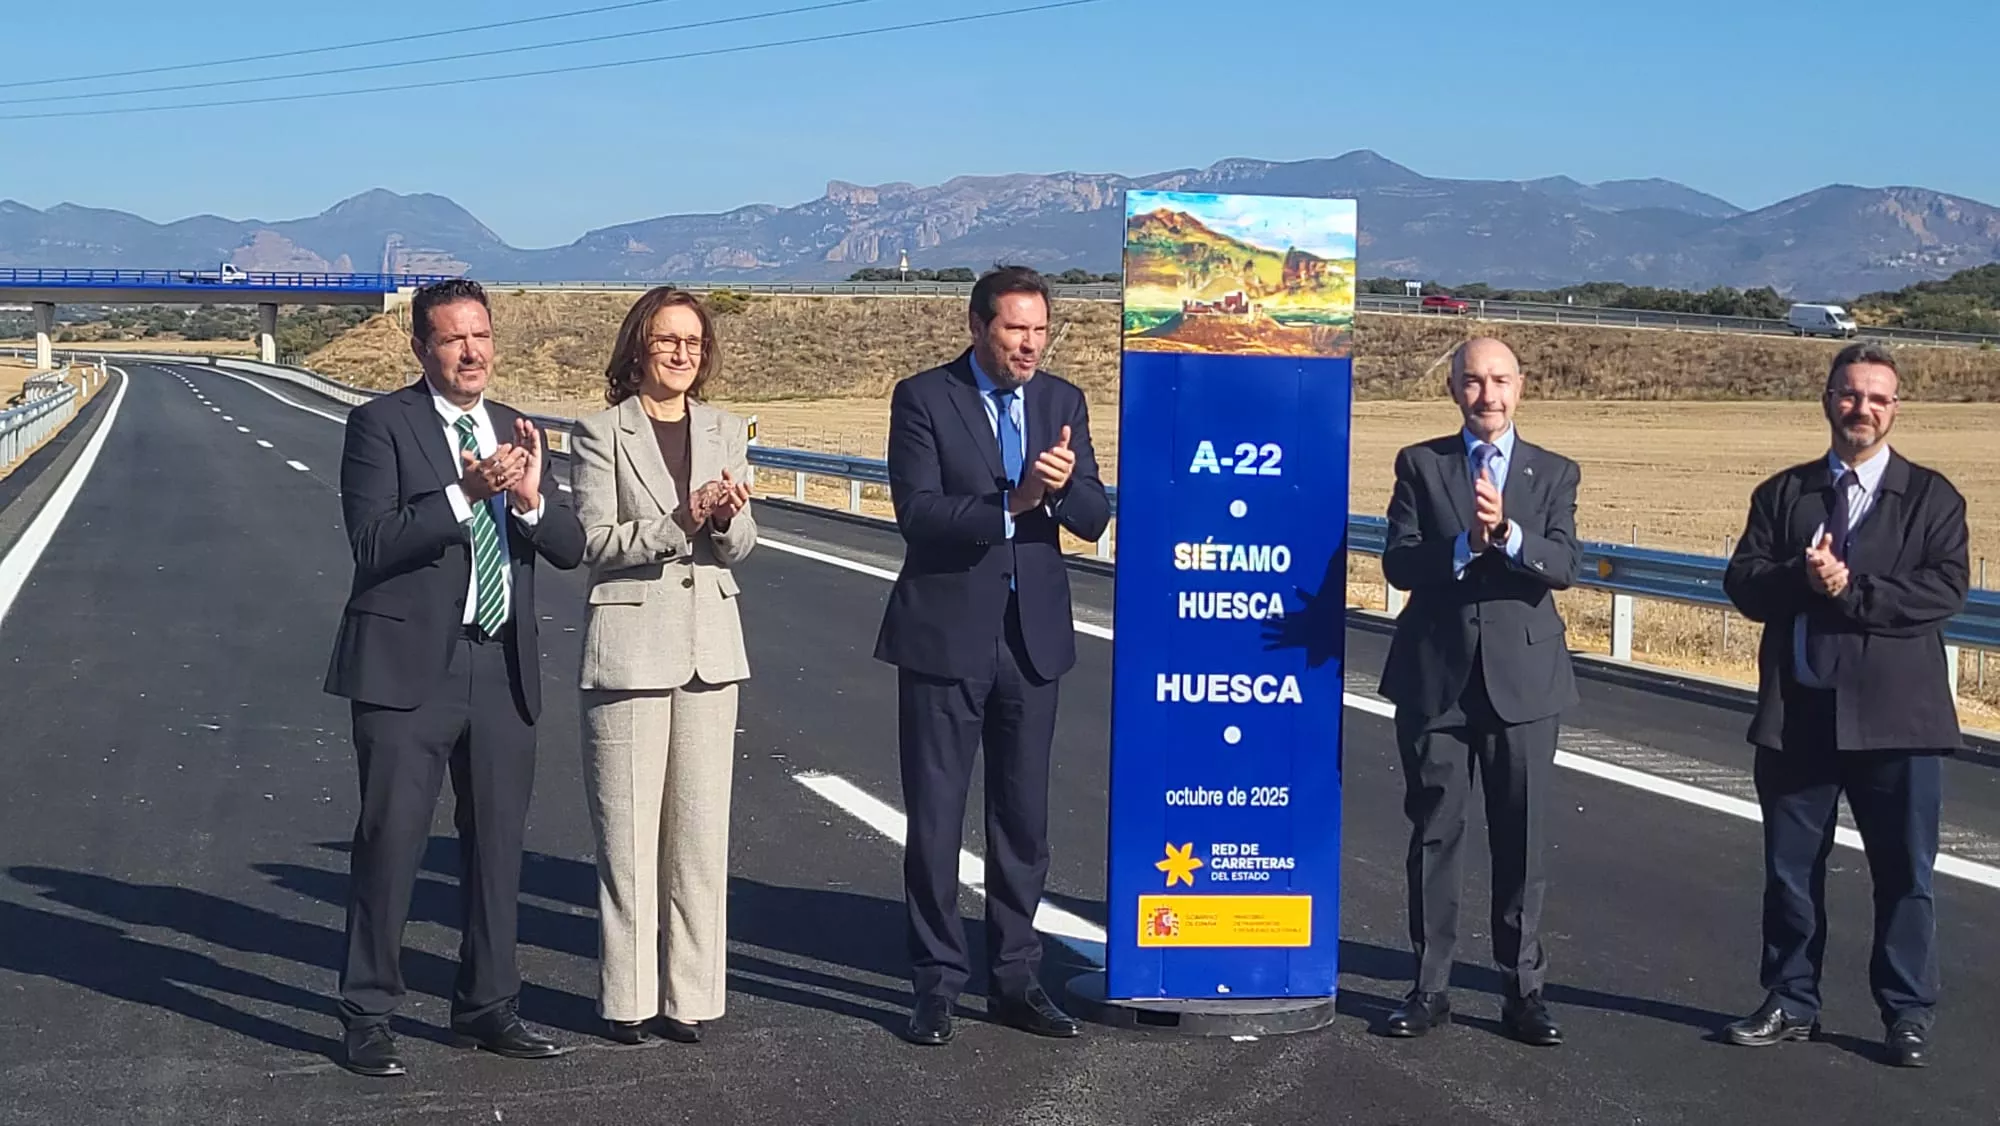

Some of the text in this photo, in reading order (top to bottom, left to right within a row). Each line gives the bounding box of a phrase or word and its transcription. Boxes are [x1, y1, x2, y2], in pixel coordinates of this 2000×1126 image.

[1190, 440, 1282, 476] A-22
[1174, 536, 1291, 573] SIÉTAMO
[1178, 592, 1284, 619] HUESCA
[1156, 674, 1303, 703] HUESCA
[1166, 786, 1289, 806] octubre de 2025
[1211, 843, 1260, 856] RED DE
[1211, 857, 1295, 869] CARRETERAS
[1211, 872, 1270, 881] DEL ESTADO
